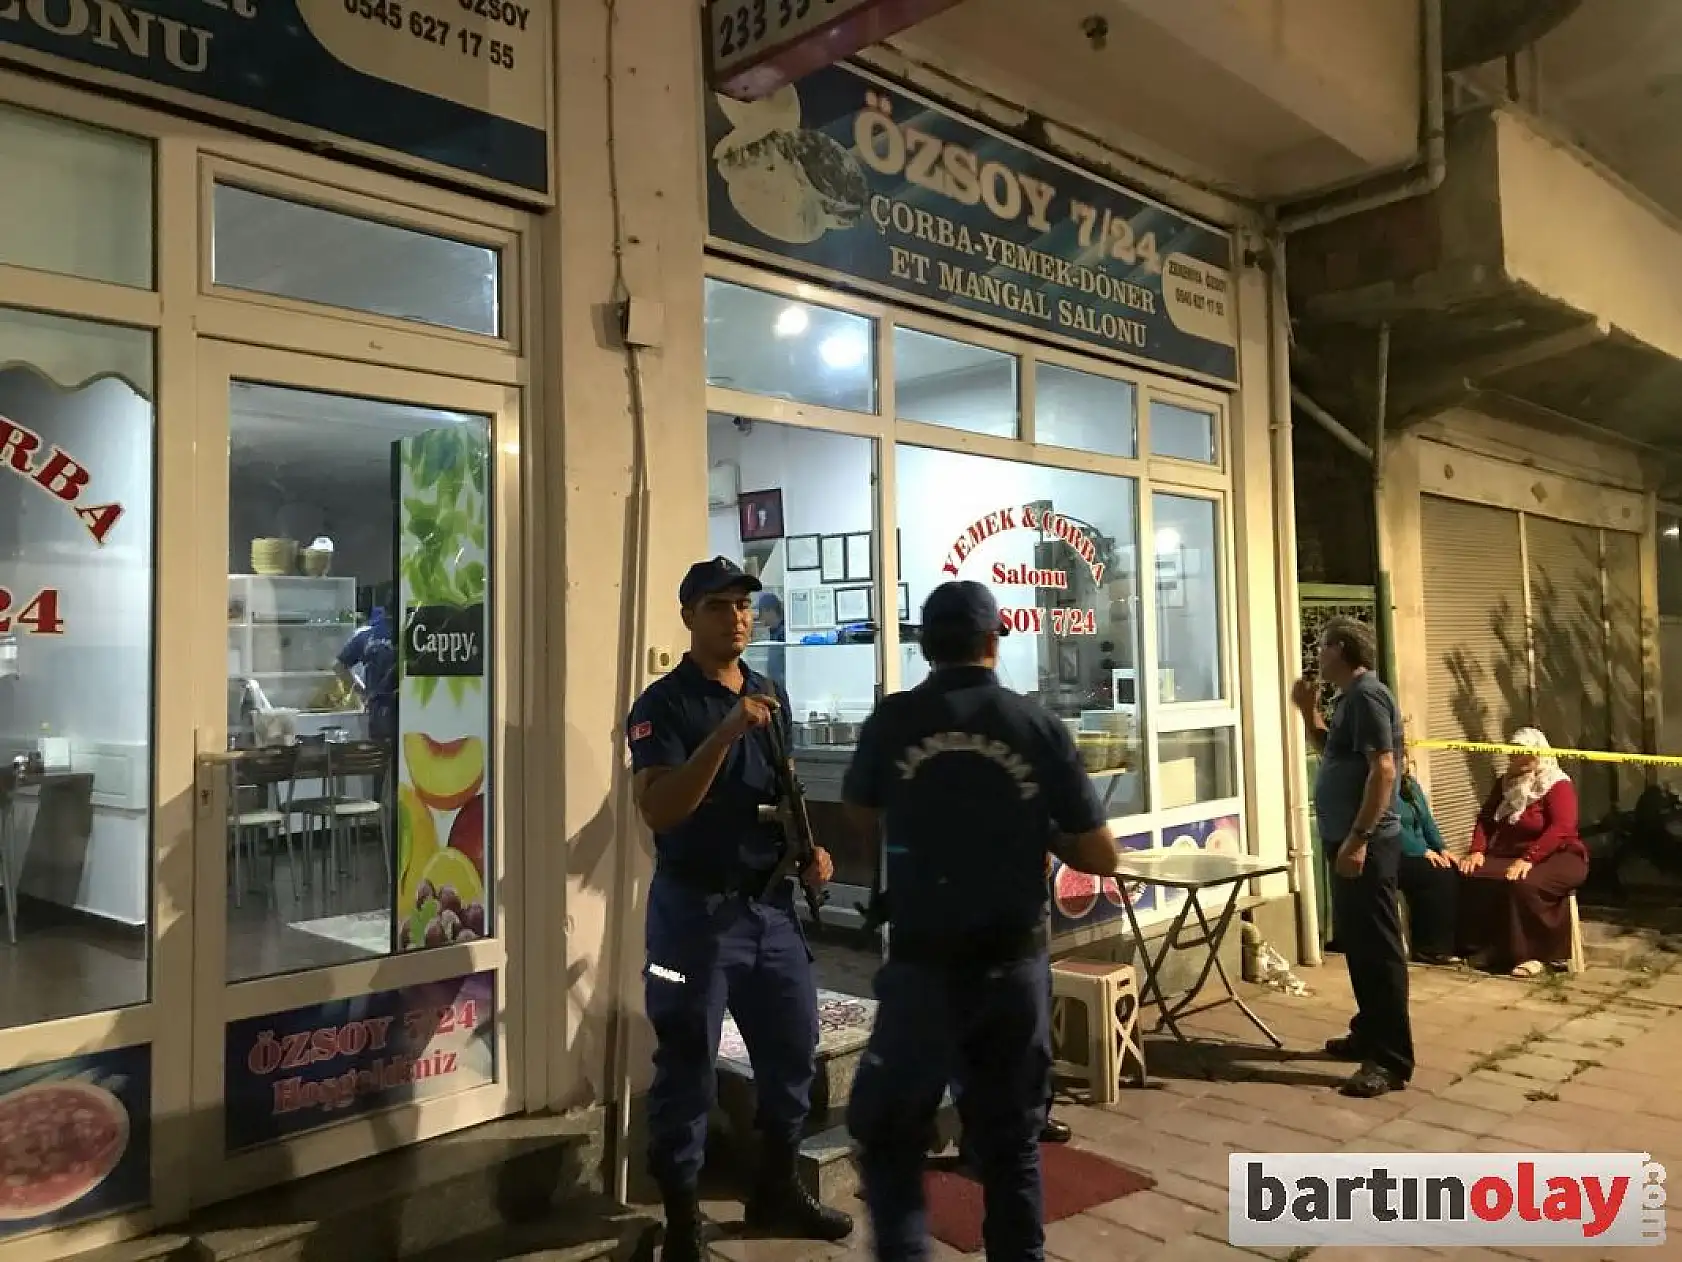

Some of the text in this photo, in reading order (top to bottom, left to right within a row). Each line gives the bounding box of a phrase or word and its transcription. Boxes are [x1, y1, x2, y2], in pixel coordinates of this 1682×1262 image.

[409, 11, 449, 46] 627
[457, 28, 483, 57] 17
[489, 39, 514, 70] 55
[854, 91, 1162, 275] ÖZSOY 7/24
[870, 194, 1156, 315] ÇORBA-YEMEK-DÖNER
[889, 245, 930, 285] ET
[938, 260, 1052, 320] MANGAL
[1058, 299, 1148, 348] SALONU
[942, 507, 1016, 579] YEMEK
[1021, 504, 1037, 529] &
[992, 561, 1068, 589] Salonu
[1052, 606, 1097, 636] 7/24
[248, 1014, 395, 1076] ÖZSOY
